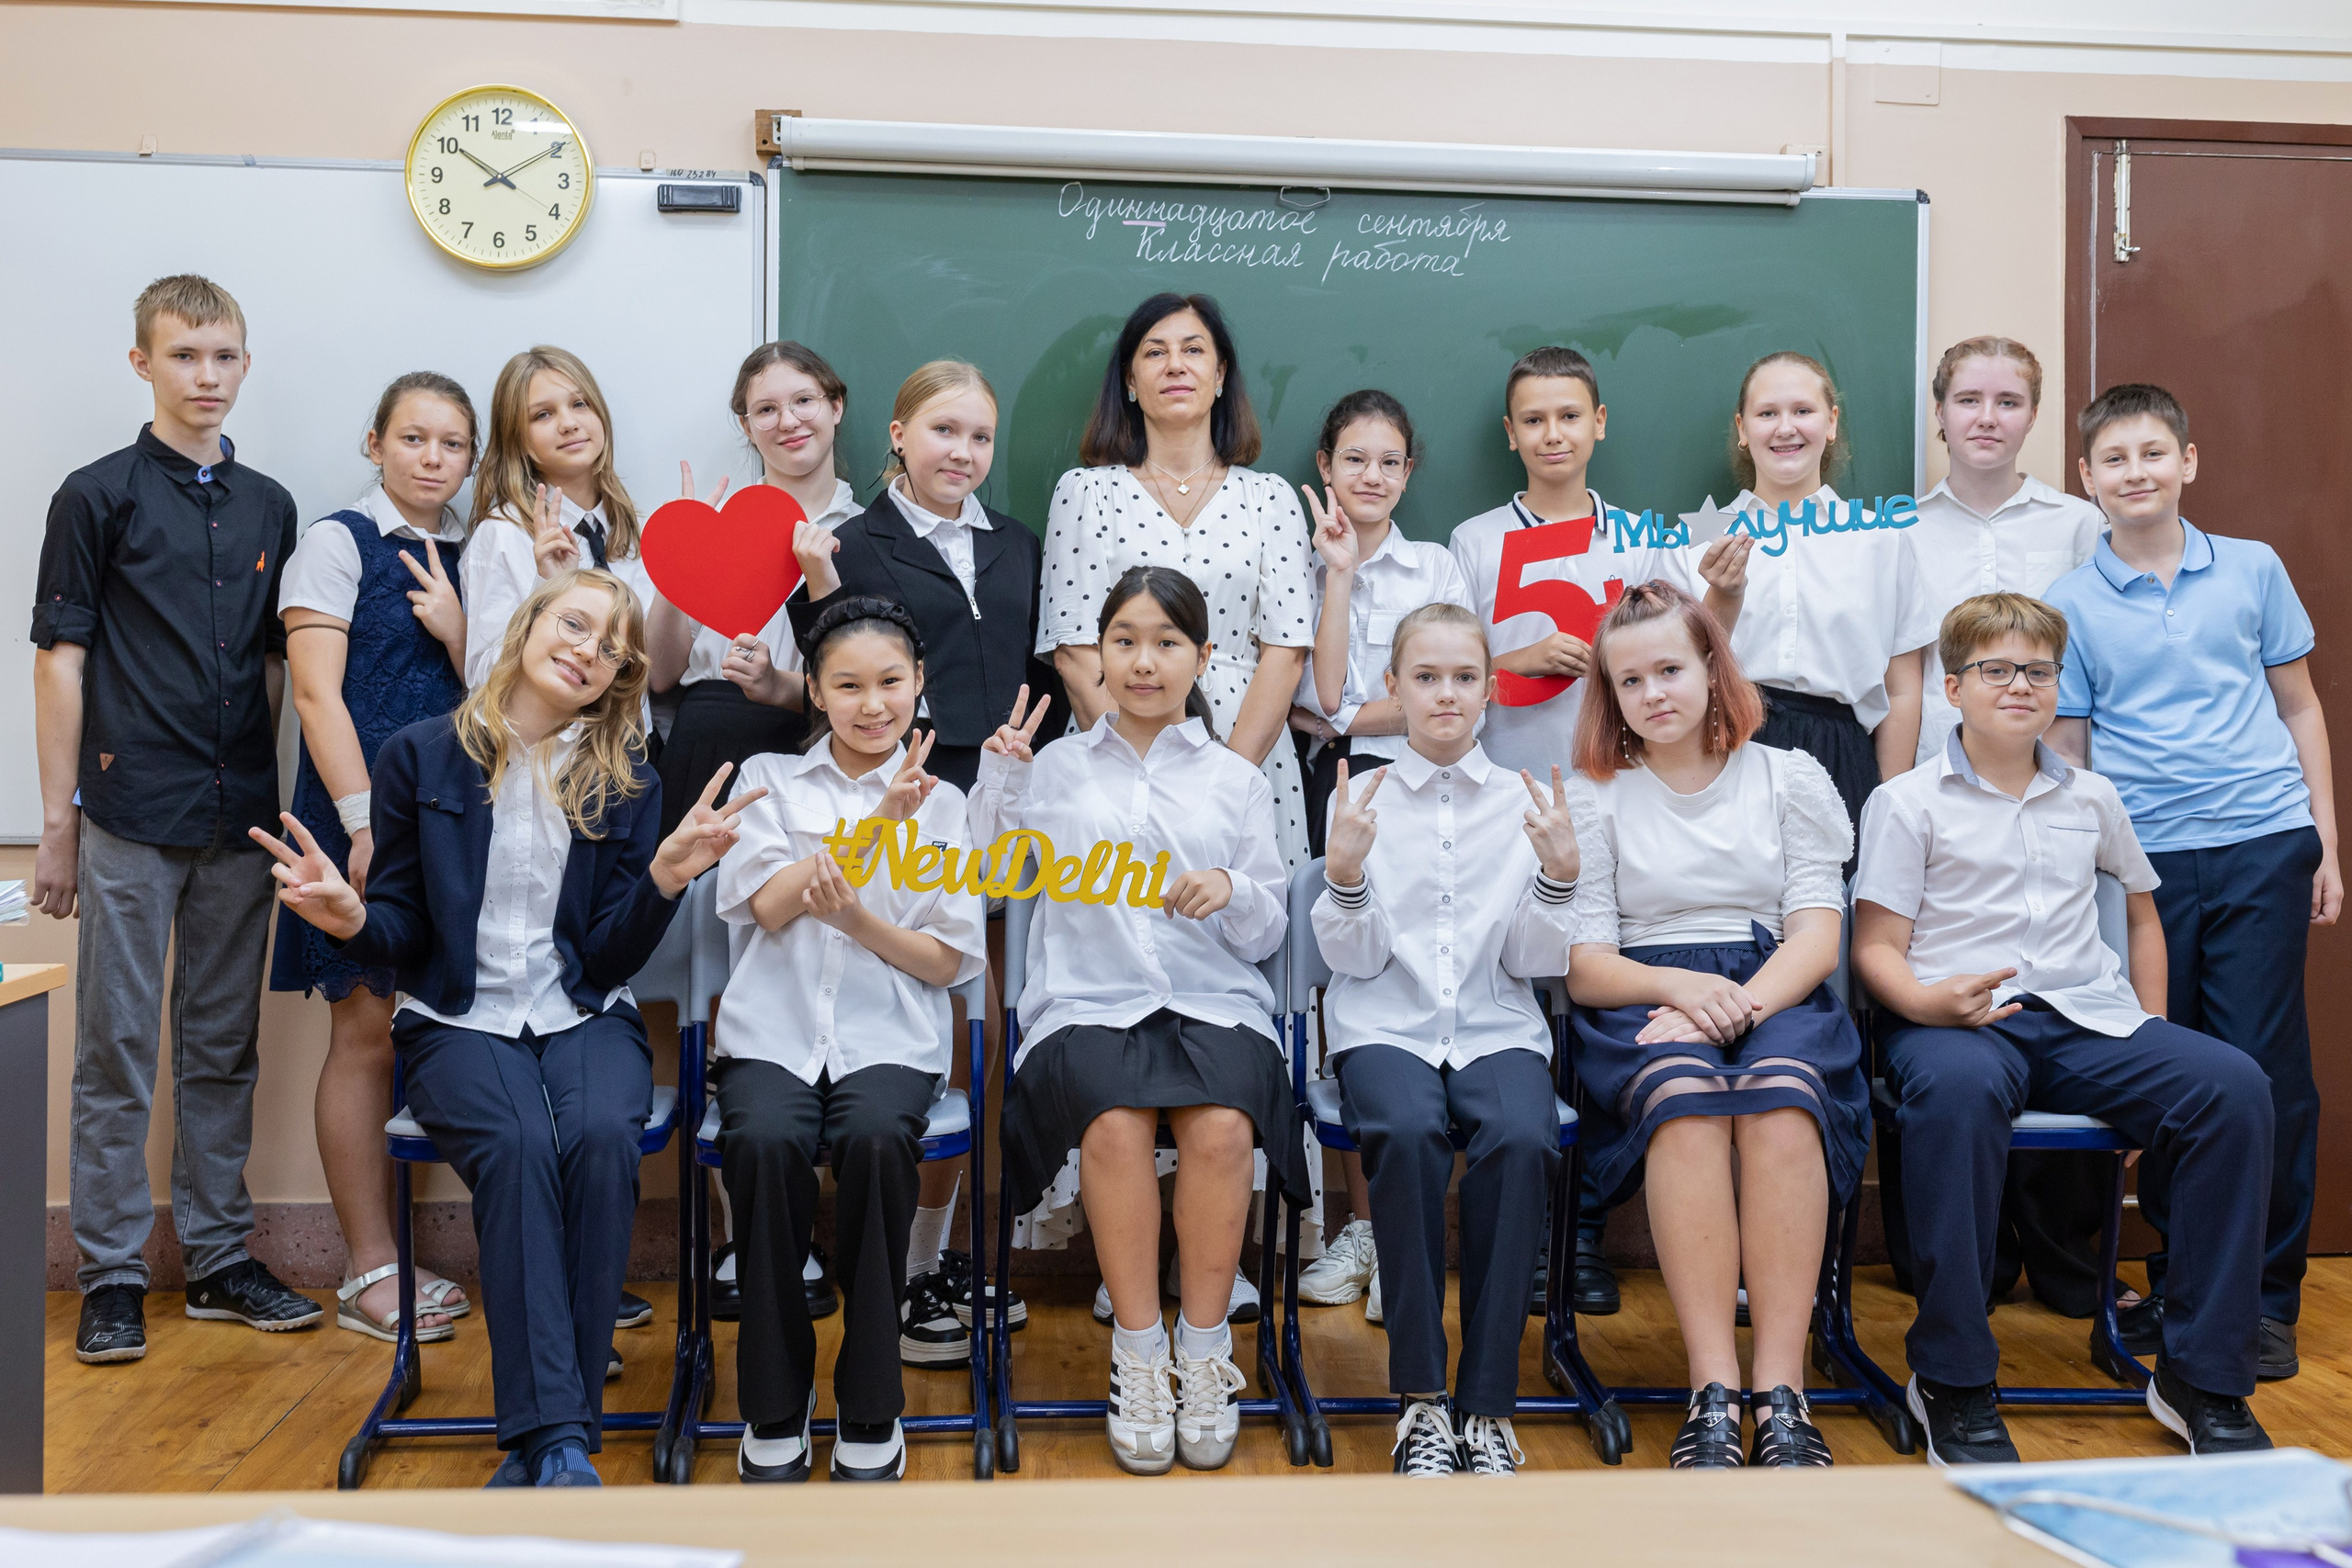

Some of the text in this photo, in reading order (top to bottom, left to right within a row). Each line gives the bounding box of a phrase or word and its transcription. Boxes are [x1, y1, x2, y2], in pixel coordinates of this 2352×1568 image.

[462, 115, 480, 132] 11
[492, 107, 513, 125] 12
[437, 137, 458, 154] 10
[549, 141, 562, 158] 2
[431, 166, 444, 184] 9
[558, 173, 570, 189] 3
[438, 198, 451, 215] 8
[548, 203, 560, 220] 4
[1058, 181, 1511, 258] Одиннадцатое сентября
[461, 221, 474, 239] 7
[525, 224, 537, 242] 5
[492, 231, 505, 248] 6
[1136, 226, 1464, 284] Классная работа
[1607, 493, 1920, 558] Мы лучшие
[822, 816, 1171, 909] #NewDelhi
